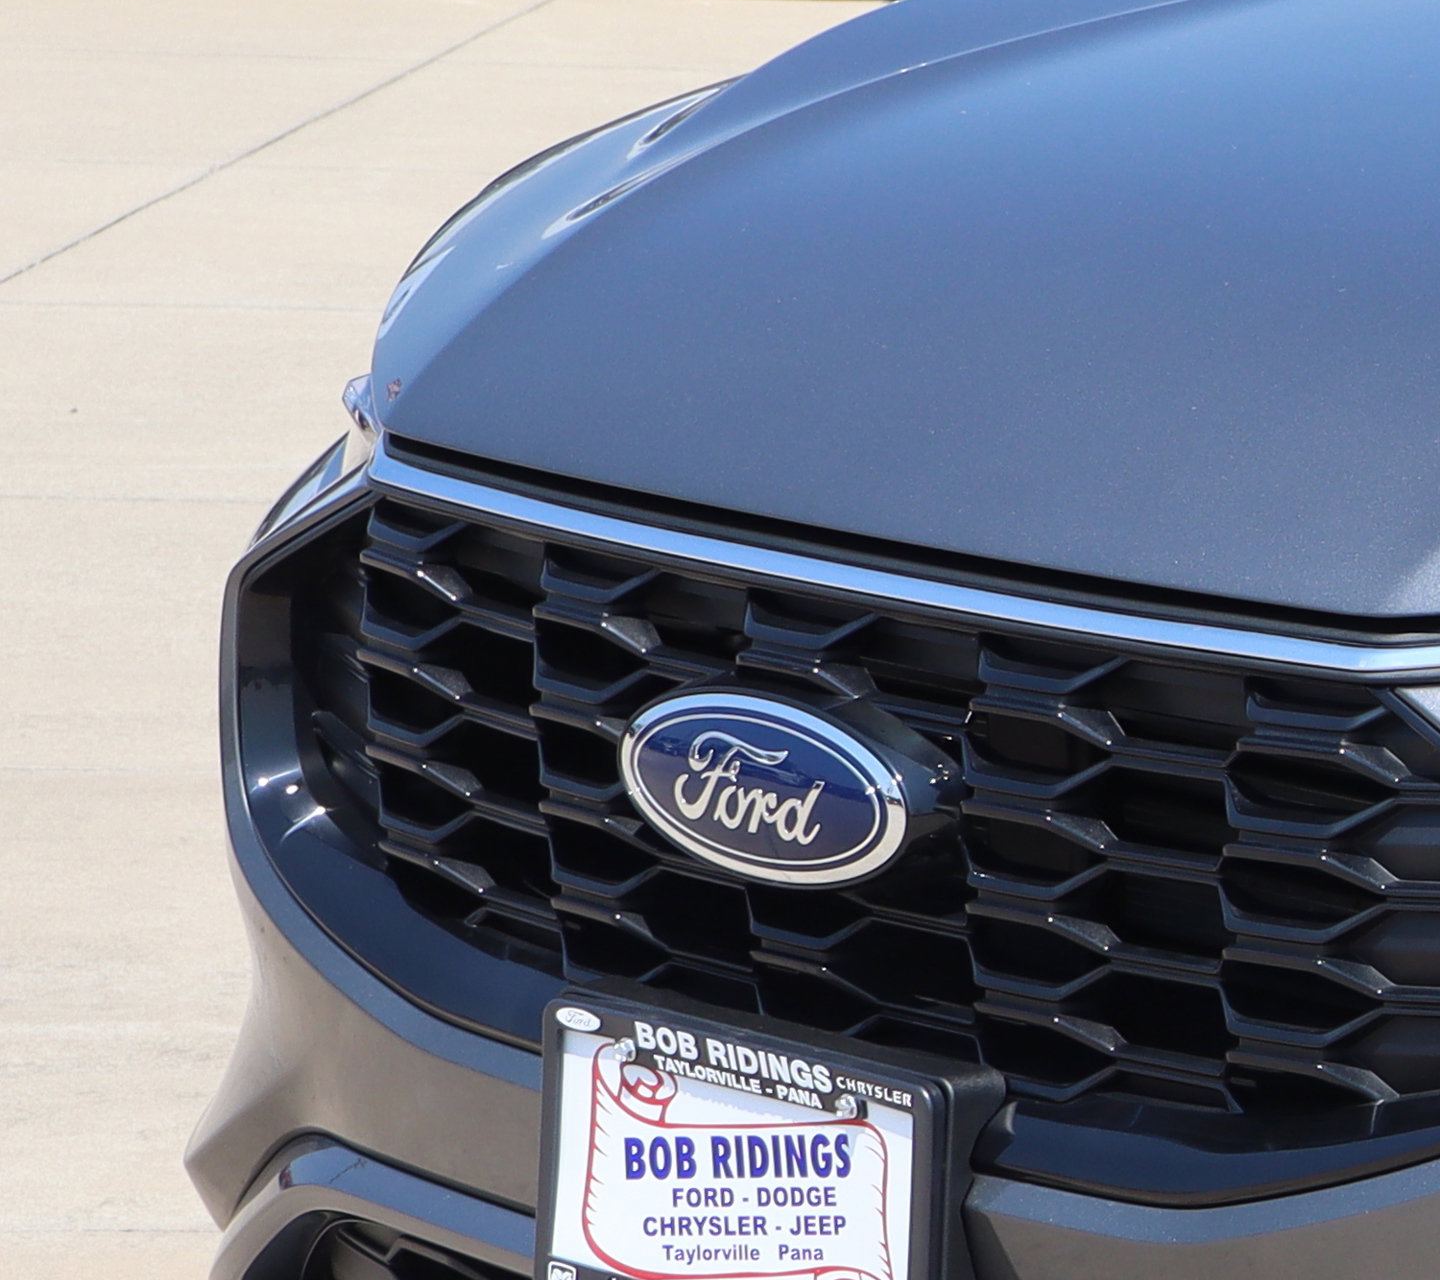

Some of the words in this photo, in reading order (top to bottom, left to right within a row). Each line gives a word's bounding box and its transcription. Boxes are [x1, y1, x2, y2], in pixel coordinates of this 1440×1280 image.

[674, 730, 827, 847] Ford
[633, 1020, 699, 1061] BOB
[705, 1037, 834, 1094] RIDINGS
[653, 1054, 762, 1095] TAYLORVILLE
[776, 1085, 823, 1110] PANA
[836, 1075, 913, 1108] CHRYSLER
[624, 1136, 699, 1180] BOB
[711, 1133, 852, 1179] RIDINGS
[672, 1187, 736, 1209] FORD
[756, 1186, 838, 1208] DODGE
[642, 1216, 768, 1238] CHRYSLER
[789, 1216, 847, 1236] JEEP
[662, 1244, 760, 1265] Taylorville
[778, 1244, 824, 1262] Pana
